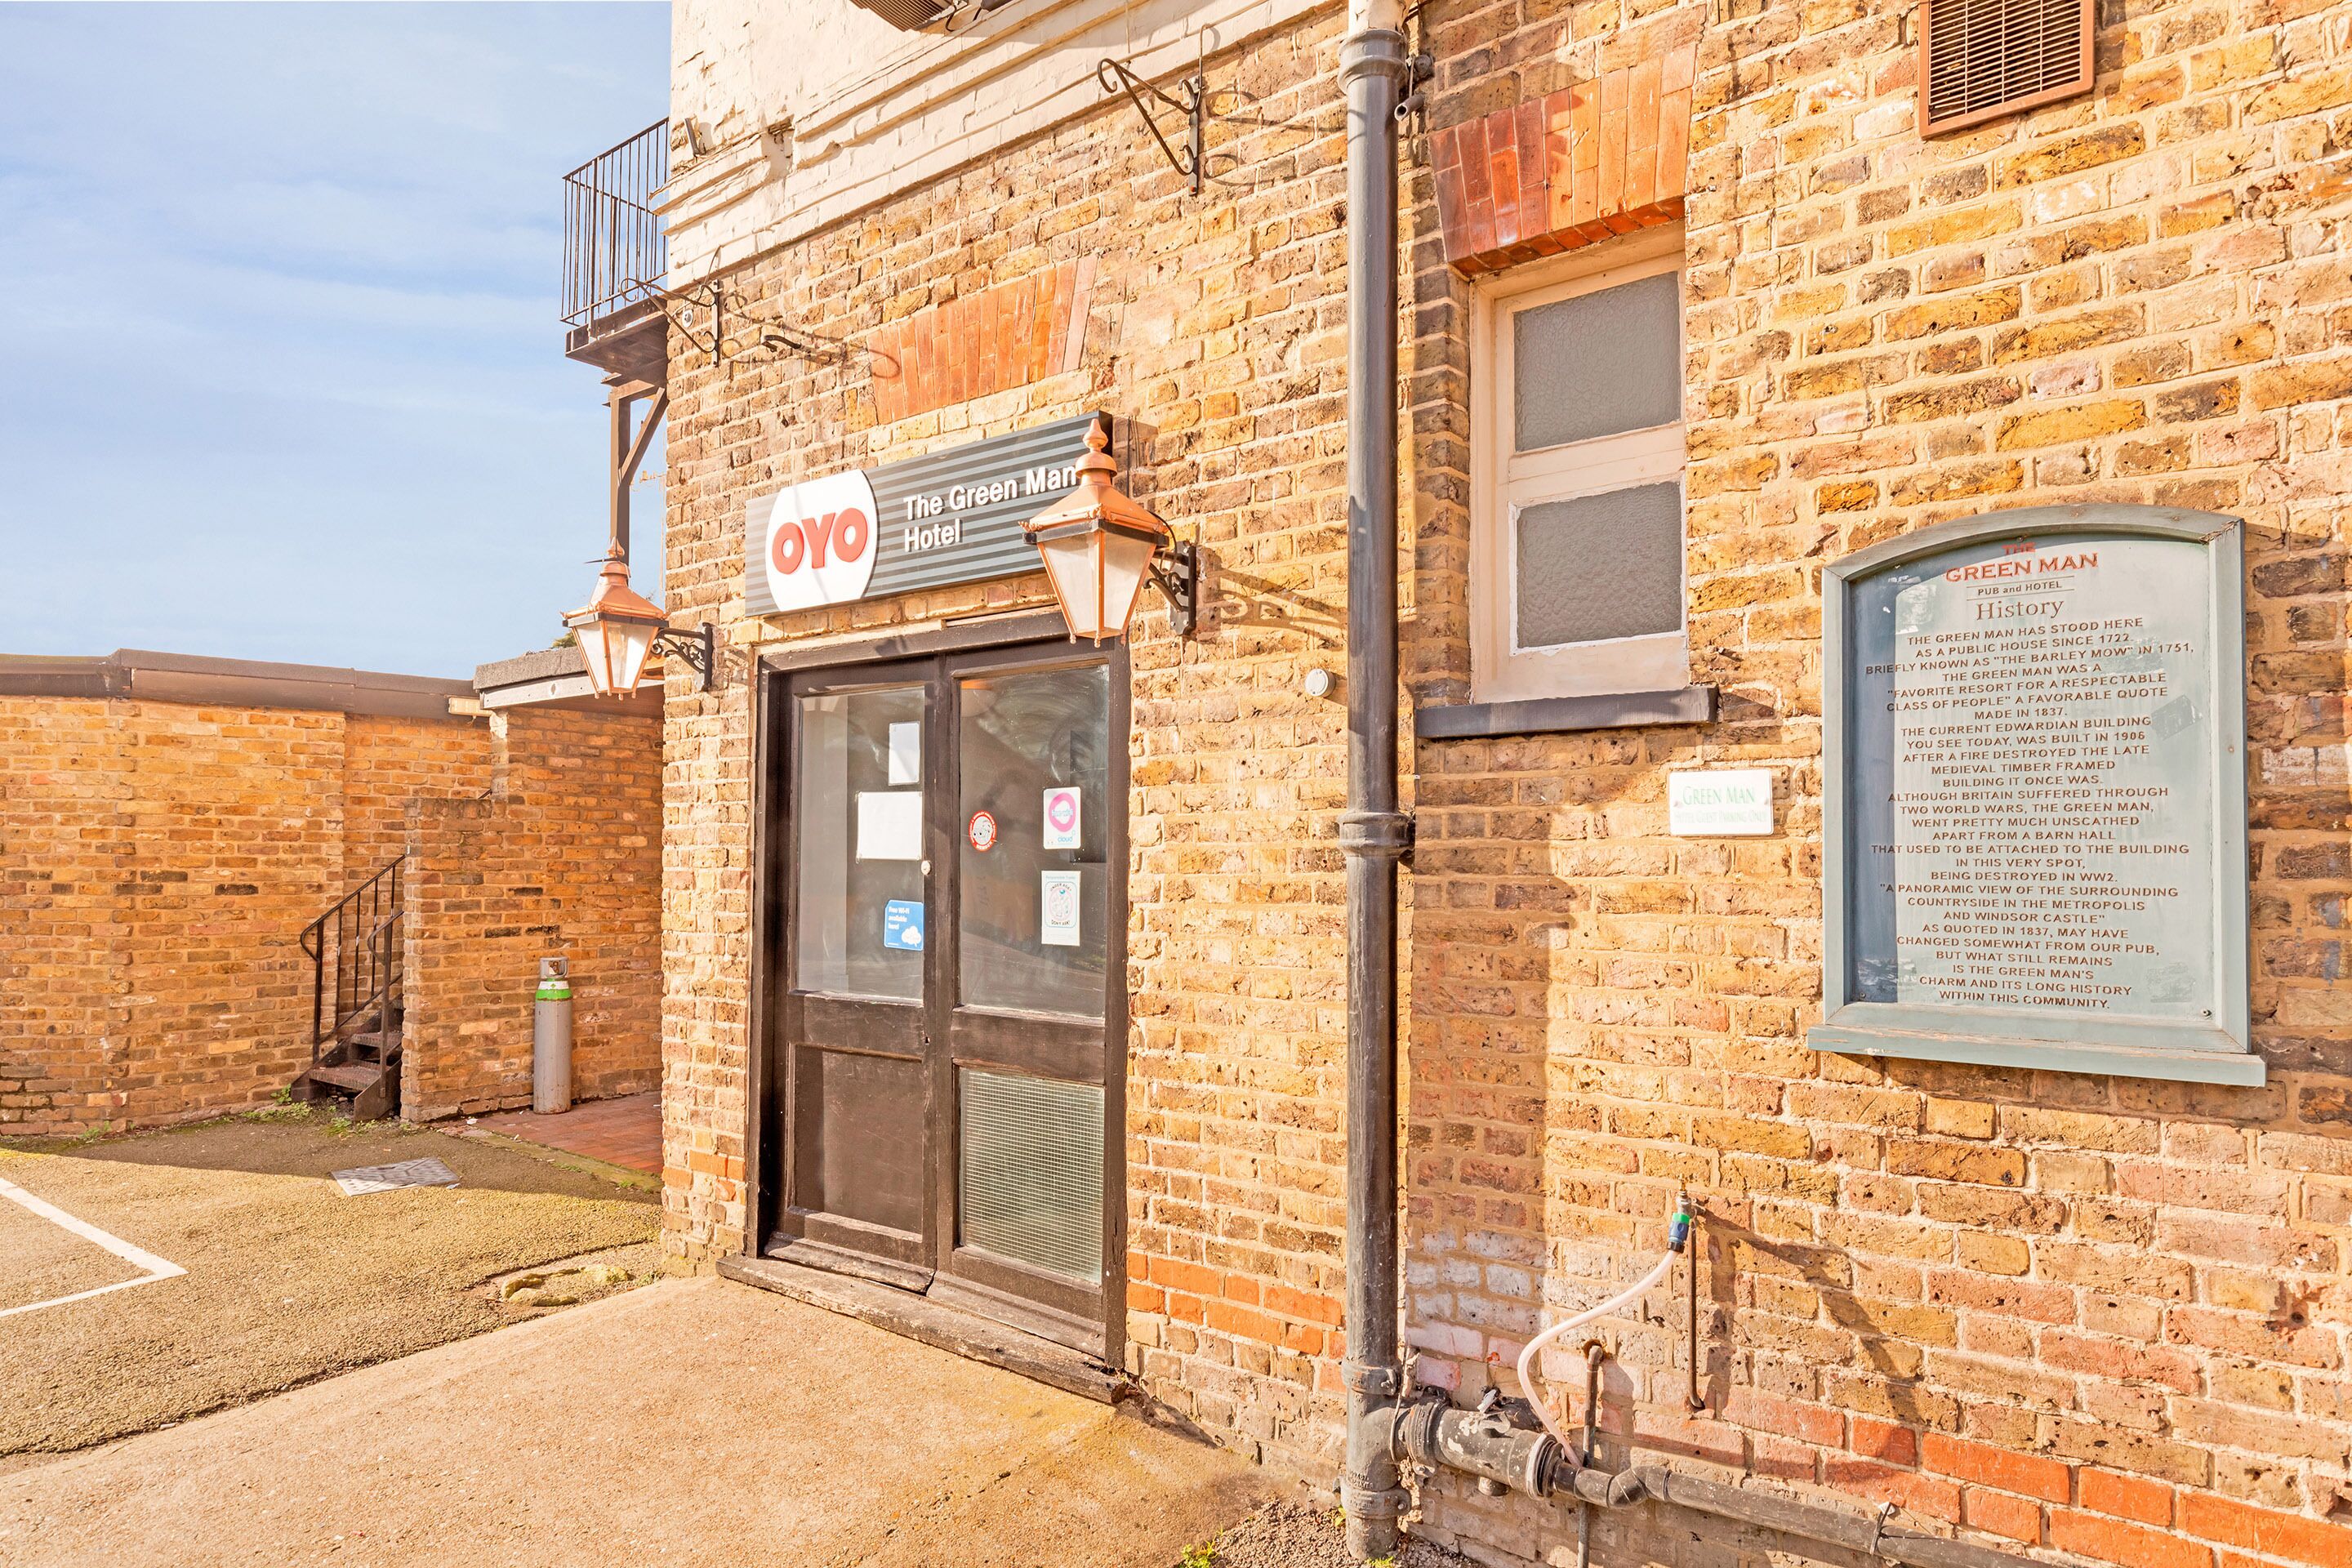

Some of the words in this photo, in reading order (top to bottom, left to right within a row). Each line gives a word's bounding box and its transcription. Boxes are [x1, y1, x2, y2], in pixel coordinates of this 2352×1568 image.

[903, 495, 943, 520] The
[949, 479, 1018, 511] Green
[1026, 466, 1076, 496] Man
[772, 507, 868, 576] OYO
[904, 518, 962, 552] Hotel
[2002, 542, 2037, 555] THE
[1946, 560, 2032, 582] GREEN
[2039, 552, 2097, 573] MAN
[1978, 584, 1999, 596] PUB
[2002, 582, 2022, 594] and
[2025, 581, 2062, 593] HOTEL
[1976, 600, 2065, 621] History
[1909, 635, 1931, 645] THE
[1936, 631, 1980, 644] GREEN
[1984, 629, 2014, 639] MAN
[2018, 626, 2046, 636] HAS
[2051, 621, 2099, 634] STOOD
[2104, 617, 2143, 630] HERE
[1916, 648, 1932, 658] AS
[1936, 648, 1945, 657] A
[1949, 644, 1996, 655] PUBLIC
[2001, 639, 2047, 652] HOUSE
[2052, 635, 2093, 647] SINCE
[2099, 633, 2134, 644] 1722.
[1865, 662, 1916, 675] BRIEFLY
[1920, 659, 1968, 670] KNOWN
[1973, 657, 1990, 666] AS
[1993, 654, 2025, 665] "THE
[2031, 650, 2087, 662] BARLEY
[2091, 647, 2133, 658] MOW"
[2138, 645, 2152, 655] IN
[2158, 643, 2194, 653] 1751,
[1942, 671, 1967, 682] THE
[1971, 669, 2017, 680] GREEN
[2022, 666, 2051, 677] MAN
[2056, 664, 2087, 675] WAS
[2092, 663, 2102, 672] A
[1887, 686, 1954, 700] "FAVORITE
[1959, 682, 2012, 694] RESORT
[2017, 681, 2045, 691] FOR
[2049, 680, 2058, 689] A
[2061, 673, 2166, 688] RESPECTABLE
[1886, 701, 1928, 712] CLASS
[1932, 699, 1949, 709] OF
[1953, 697, 2011, 708] PEOPLE"
[2015, 694, 2024, 704] A
[2028, 690, 2111, 704] FAVORABLE
[2117, 687, 2167, 699] QUOTE
[1975, 709, 2011, 719] MADE
[2017, 709, 2029, 718] IN
[2034, 707, 2068, 717] 1837.
[1901, 727, 1924, 737] THE
[1929, 724, 1991, 735] CURRENT
[1996, 720, 2078, 733] EDWARDIAN
[2084, 716, 2151, 728] BUILDING
[1907, 740, 1933, 750] YOU
[1937, 738, 1962, 748] SEE
[1967, 737, 2012, 746] TODAY,
[2016, 735, 2047, 745] WAS
[2051, 733, 2091, 743] BUILT
[2096, 733, 2109, 742] IN
[1903, 753, 1944, 763] AFTER
[1949, 753, 1957, 761] A
[1961, 751, 1989, 760] FIRE
[1993, 748, 2076, 760] DESTROYED
[2081, 746, 2108, 756] THE
[2114, 745, 2149, 755] LATE
[1931, 764, 1996, 774] MEDIEVAL
[2001, 763, 2051, 773] TIMBER
[2056, 760, 2115, 771] FRAMED
[1943, 777, 2004, 787] BUILDING
[2009, 777, 2020, 786] IT
[2025, 776, 2063, 786] ONCE
[2067, 775, 2103, 784] WAS.
[1682, 786, 1722, 805] GREEN
[1726, 785, 1756, 804] MAN
[1888, 792, 1957, 803] ALTHOUGH
[1962, 791, 2012, 800] BRITAIN
[2018, 789, 2091, 800] SUFFERED
[2096, 787, 2167, 797] THROUGH
[1900, 805, 1928, 814] TWO
[1932, 805, 1980, 814] WORLD
[1984, 804, 2027, 814] WARS,
[2032, 804, 2058, 813] THE
[2063, 802, 2112, 812] GREEN
[2118, 802, 2154, 813] MAN,
[1912, 818, 1949, 827] WENT
[1953, 817, 2004, 826] PRETTY
[2007, 817, 2047, 826] MUCH
[2052, 816, 2140, 826] UNSCATHED
[1871, 844, 1902, 854] THAT
[1906, 844, 1940, 853] USED
[1945, 844, 1962, 853] TO
[1967, 844, 1983, 853] BE
[1988, 844, 2059, 854] ATTACHED
[2063, 844, 2081, 854] TO
[2086, 844, 2114, 853] THE
[2119, 844, 2189, 854] BUILDING
[1956, 858, 1968, 867] IN
[1975, 858, 2002, 867] THIS
[2006, 858, 2042, 867] VERY
[2047, 858, 2086, 869] SPOT,
[1931, 871, 1971, 880] BEING
[1975, 871, 2057, 881] DESTROYED
[2062, 872, 2075, 881] IN
[2079, 872, 2118, 882] WW2.
[1880, 884, 1895, 893] "A
[1898, 884, 1973, 893] PANORAMIC
[1978, 885, 2011, 894] VIEW
[2016, 885, 2034, 894] OF
[2038, 885, 2065, 895] THE
[2069, 886, 2178, 897] SURROUNDING
[1908, 897, 1999, 908] COUNTRYSIDE
[2004, 899, 2016, 908] IN
[2020, 899, 2047, 908] THE
[2051, 900, 2145, 911] METROPOLIS
[1944, 911, 1970, 920] AND
[1975, 912, 2038, 922] WINDSOR
[2043, 913, 2105, 924] CASTLE"
[1922, 924, 1939, 933] AS
[1944, 924, 1998, 934] QUOTED
[2002, 926, 2015, 934] IN
[2020, 927, 2053, 938] 1837,
[2058, 928, 2087, 938] MAY
[2091, 929, 2128, 938] HAVE
[1897, 936, 1959, 947] CHANGED
[1963, 938, 2041, 950] SOMEWHAT
[2046, 941, 2086, 951] FROM
[2091, 942, 2121, 952] OUR
[2126, 944, 2159, 956] PUB,
[1953, 964, 1964, 973] IS
[1968, 965, 1993, 975] THE
[1998, 967, 2045, 977] GREEN
[2050, 969, 2094, 980] MAN'S
[1919, 976, 1966, 987] CHARM
[1970, 979, 1998, 988] AND
[2002, 980, 2022, 990] ITS
[2027, 982, 2065, 992] LONG
[2070, 984, 2132, 996] HISTORY
[1939, 991, 1984, 1001] WITHIN
[1989, 993, 2019, 1004] THIS
[2023, 995, 2109, 1009] COMMUNITY.
